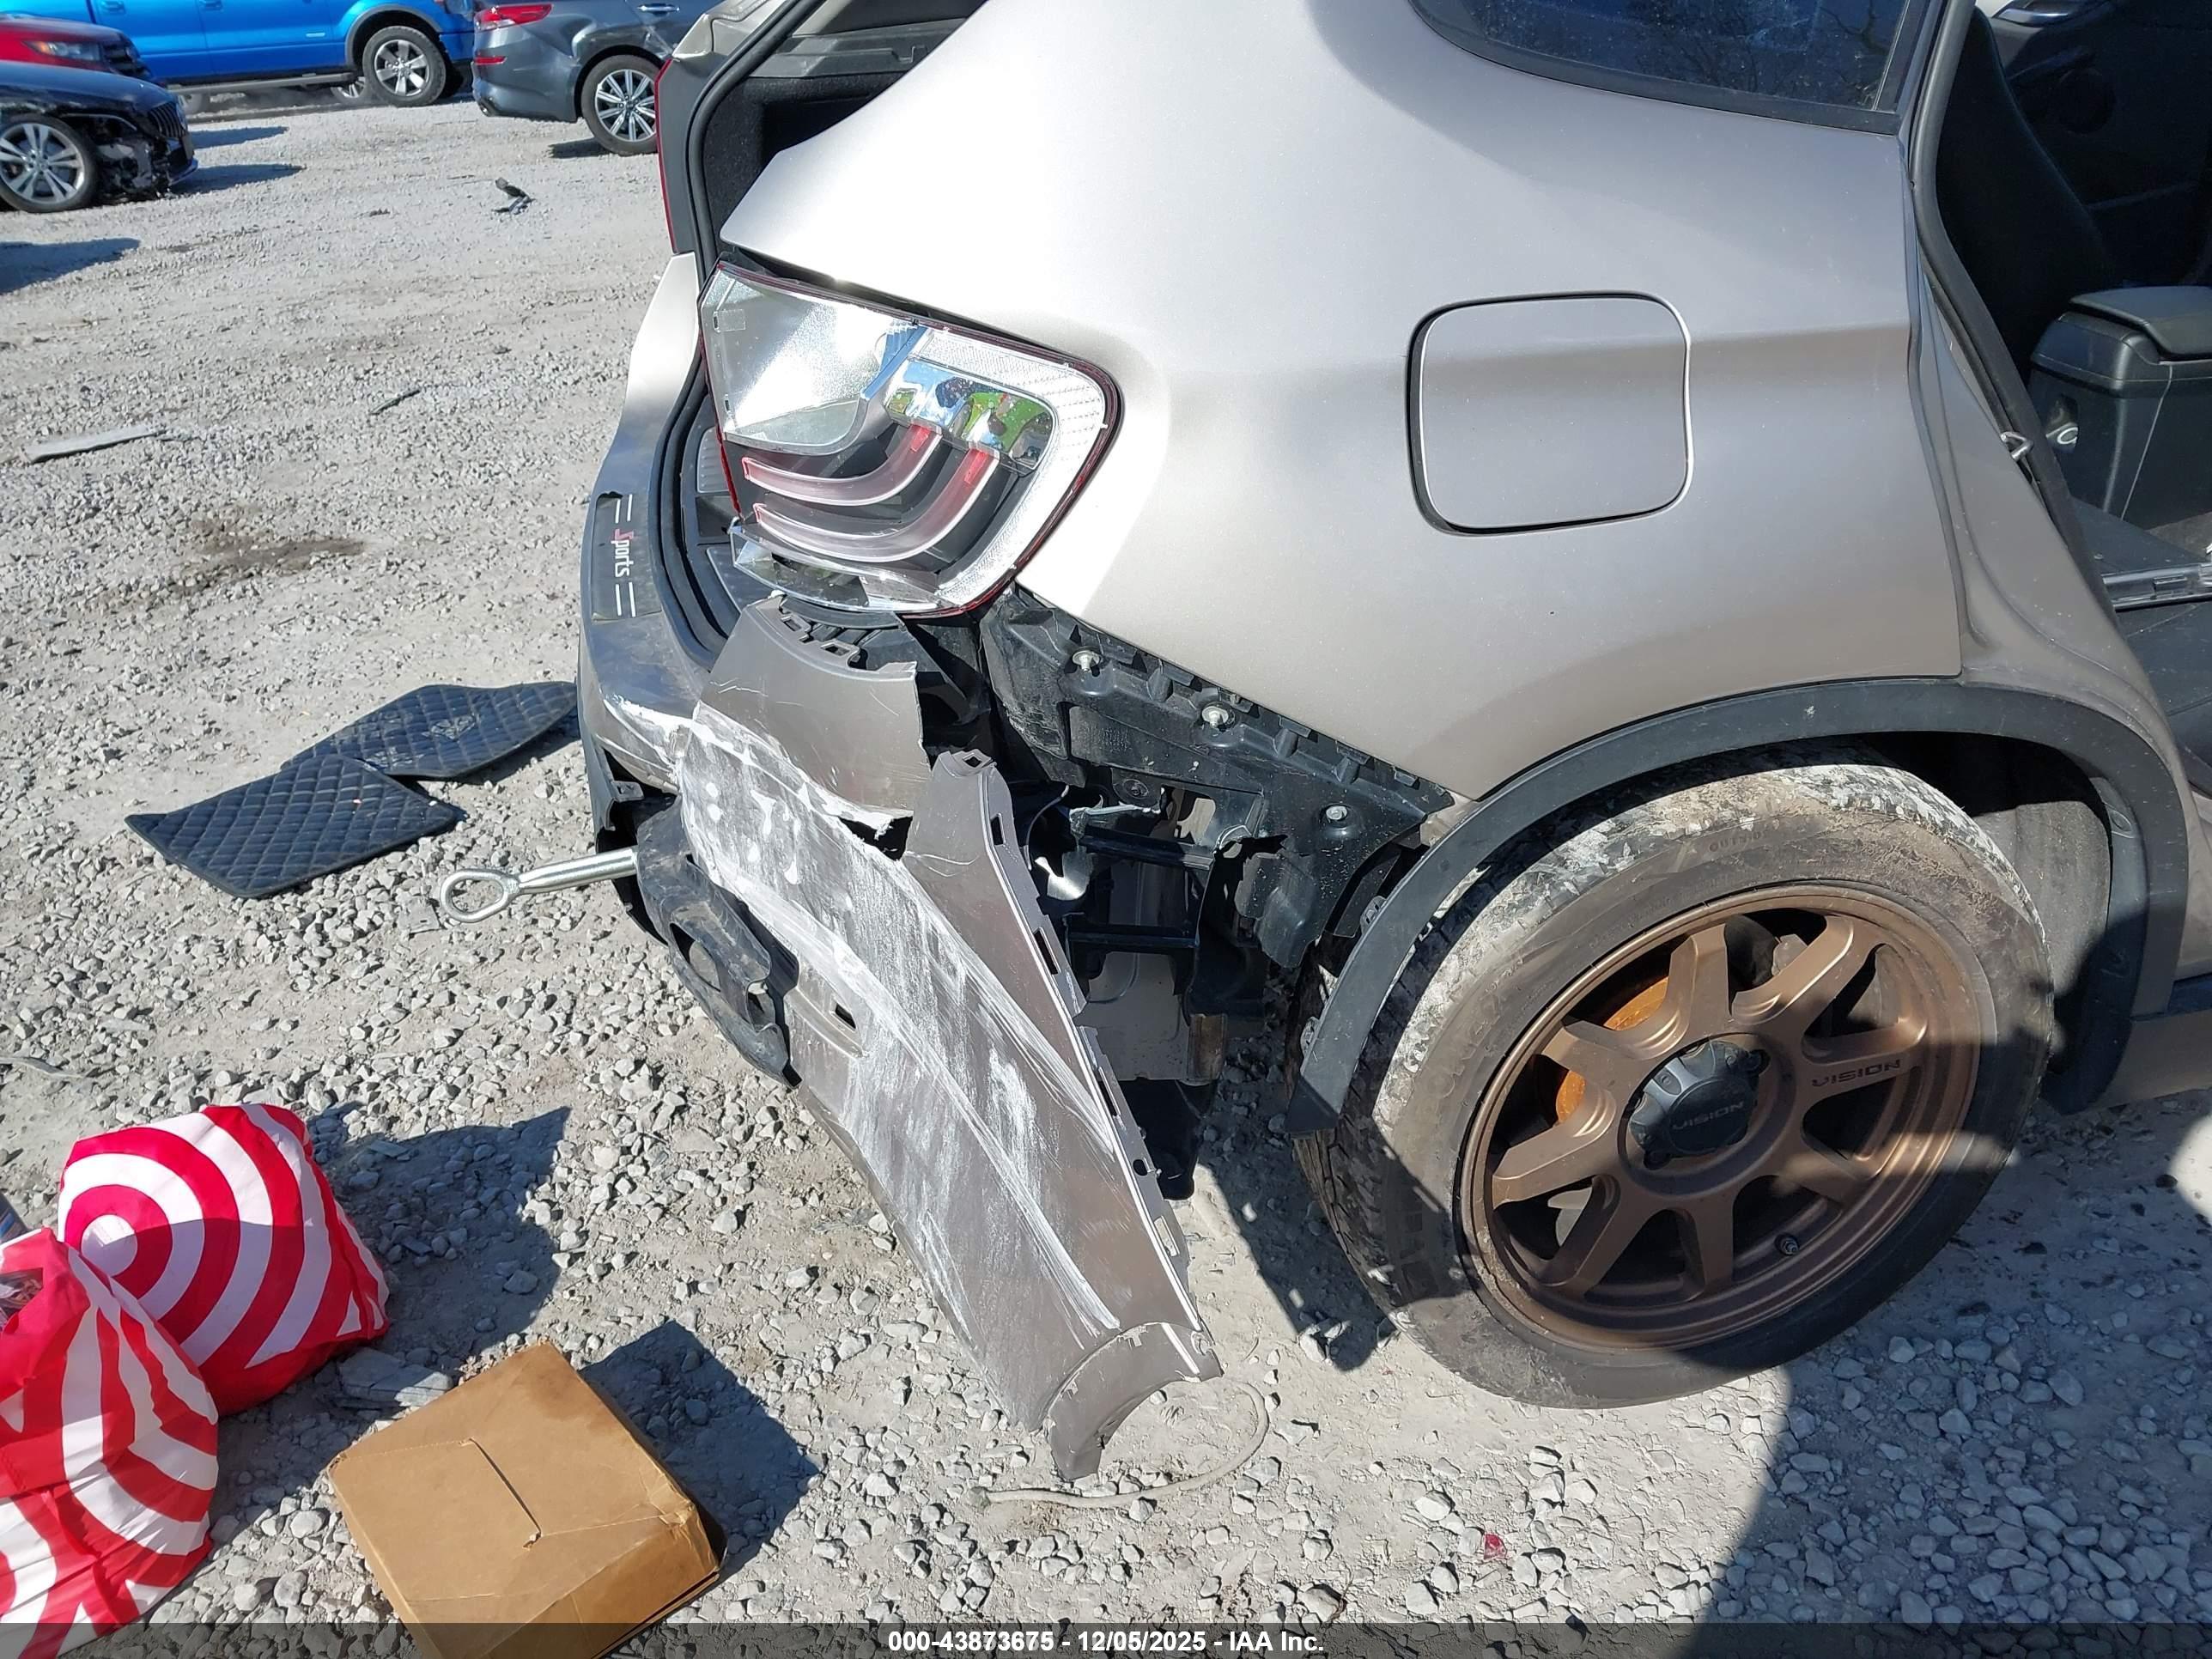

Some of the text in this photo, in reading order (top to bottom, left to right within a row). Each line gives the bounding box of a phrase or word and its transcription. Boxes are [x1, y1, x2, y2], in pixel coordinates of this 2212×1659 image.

[611, 528, 635, 578] Sports
[1811, 1059, 1900, 1087] VISION
[1672, 1102, 1744, 1130] VISION
